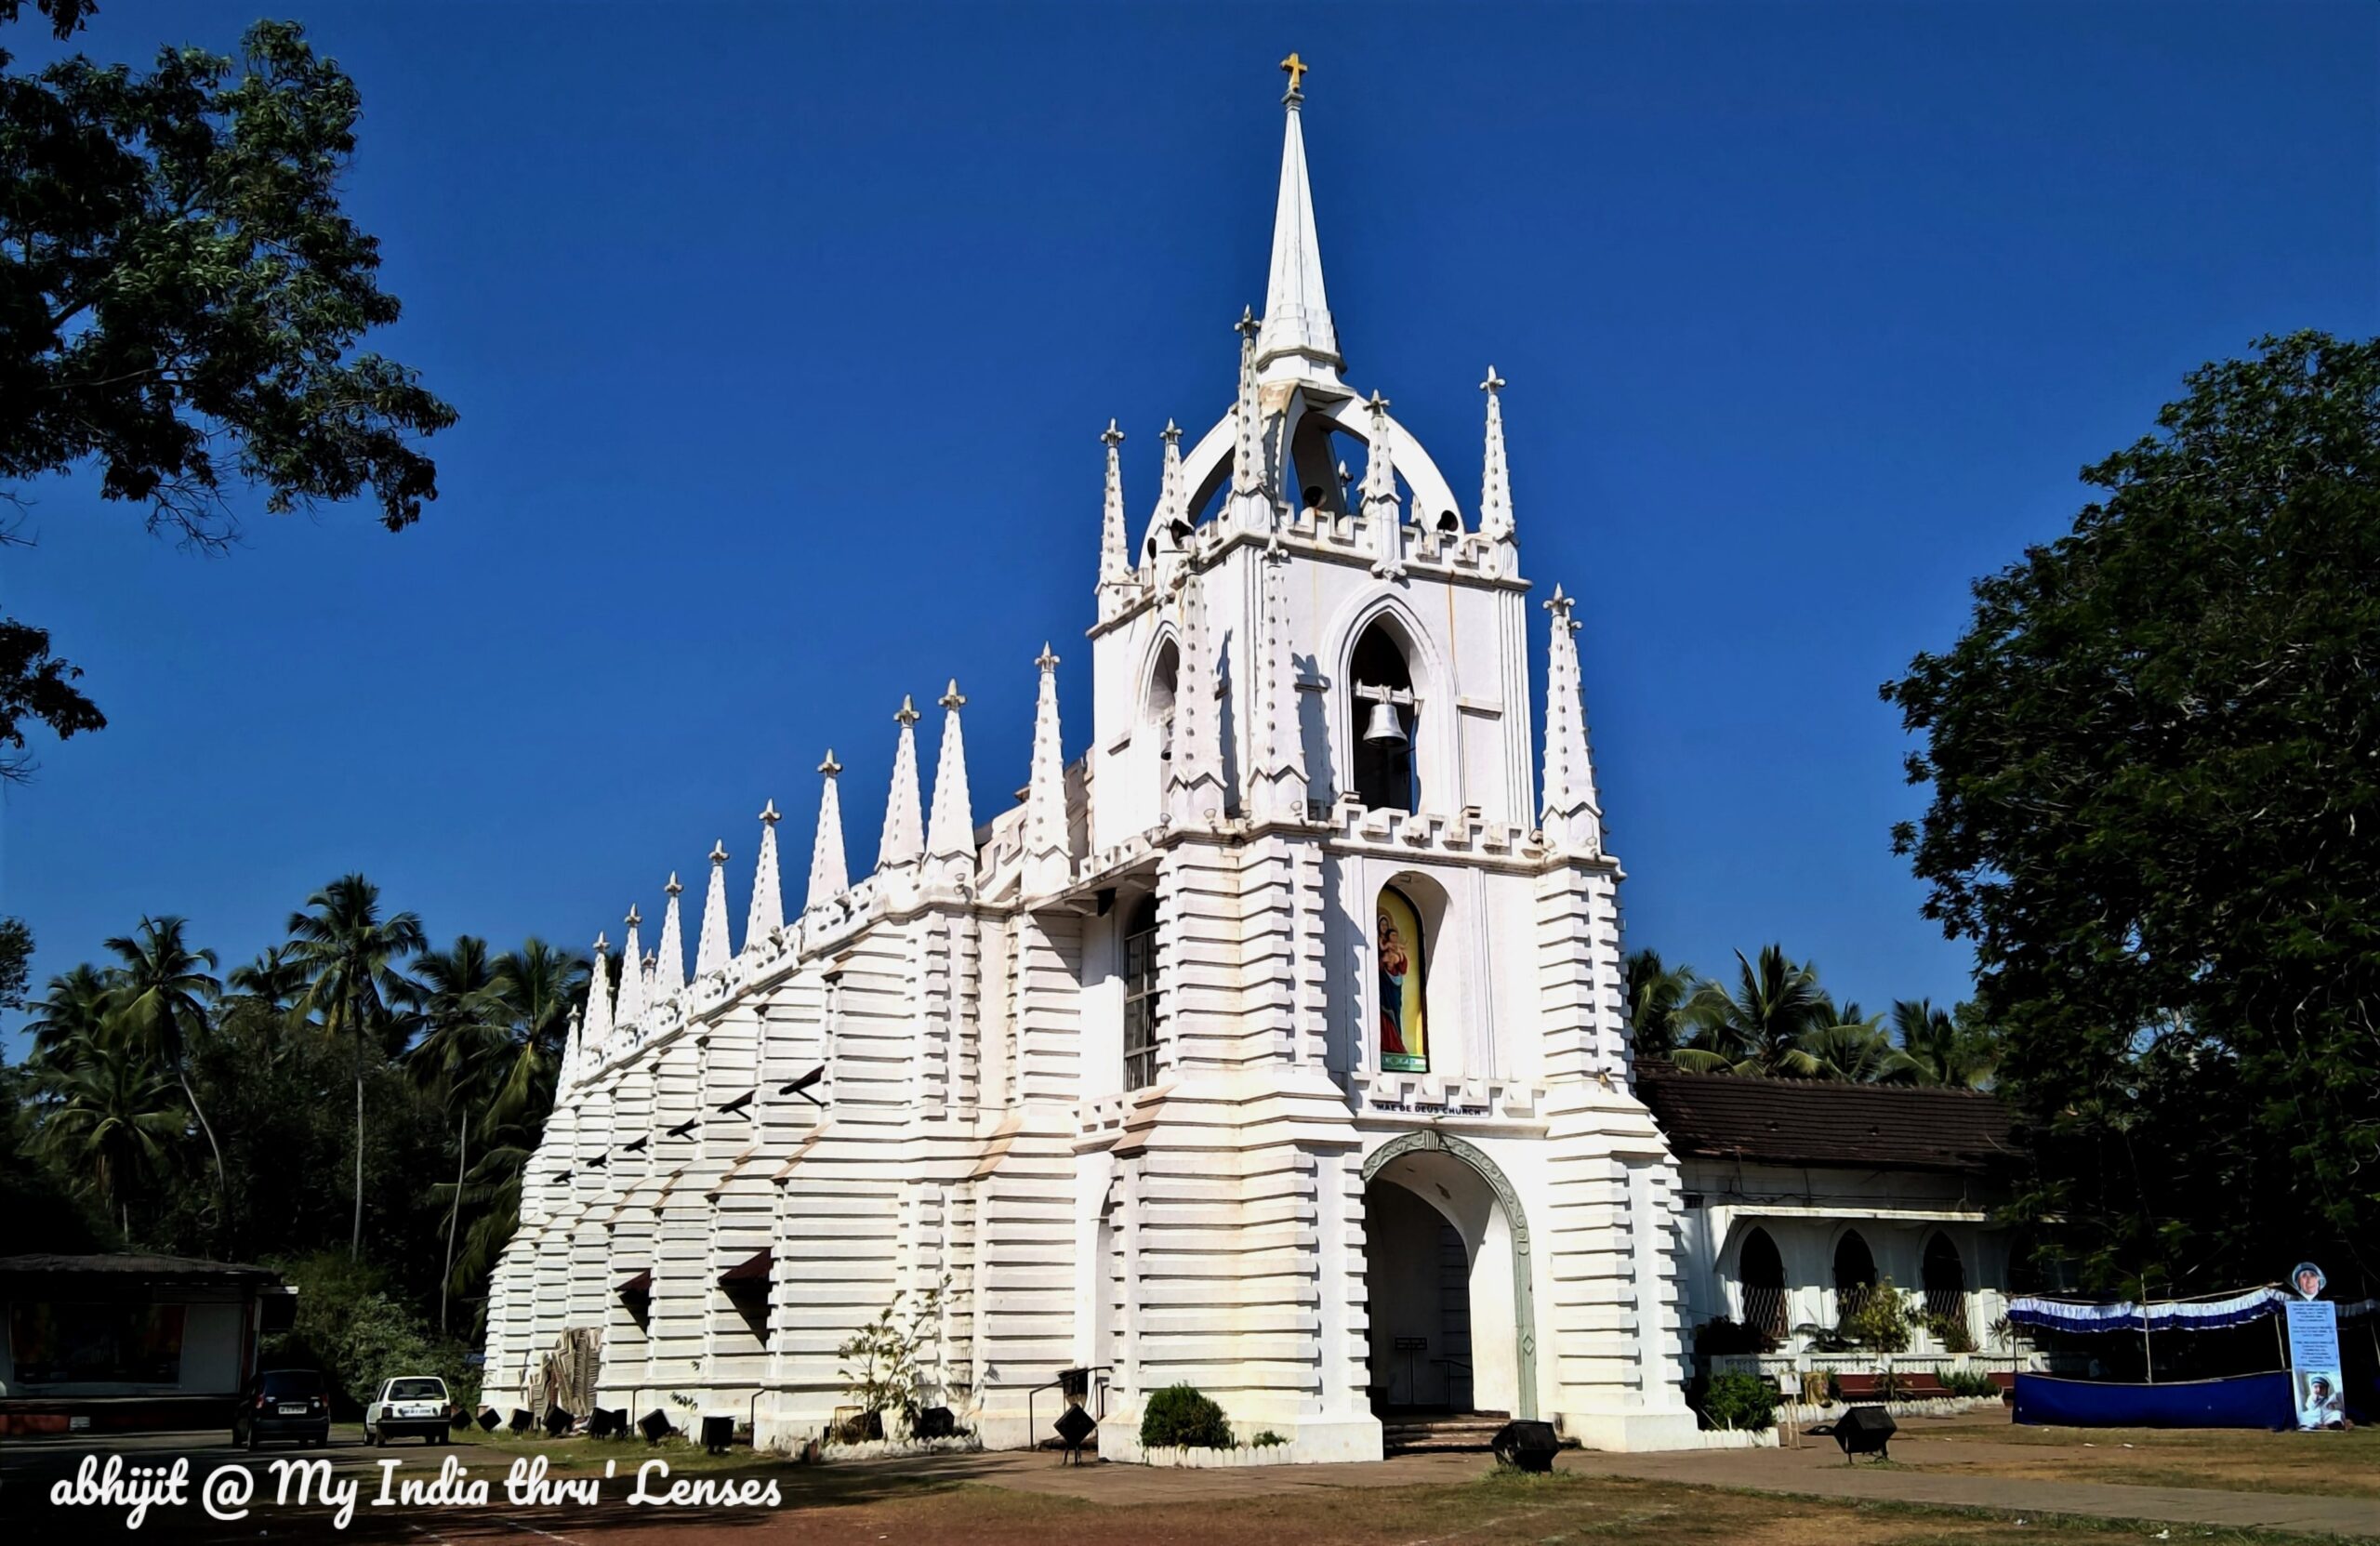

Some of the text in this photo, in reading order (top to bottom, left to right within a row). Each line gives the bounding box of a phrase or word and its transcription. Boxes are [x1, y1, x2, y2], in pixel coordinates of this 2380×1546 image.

[1376, 1103, 1481, 1116] MAE DE DEUS CHURCH
